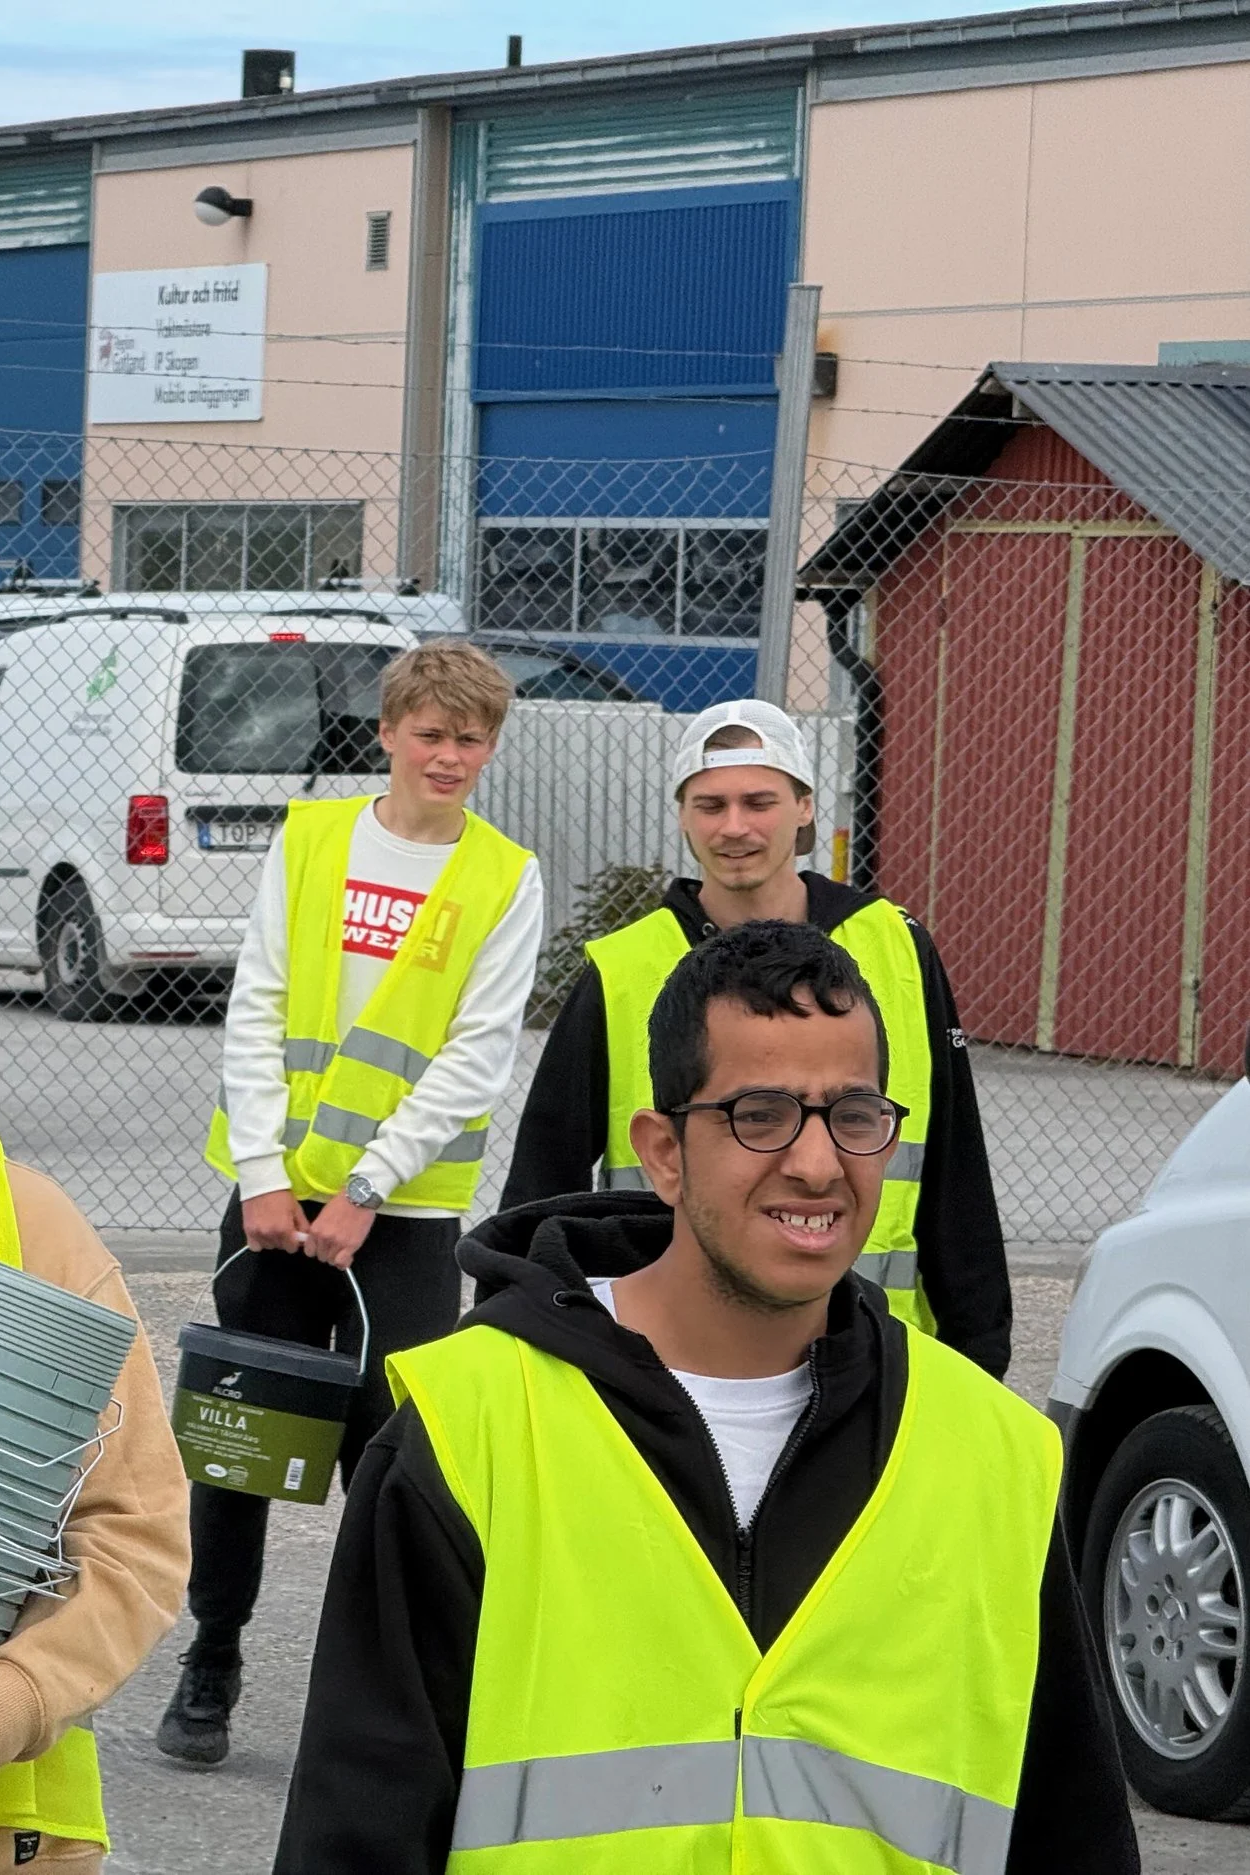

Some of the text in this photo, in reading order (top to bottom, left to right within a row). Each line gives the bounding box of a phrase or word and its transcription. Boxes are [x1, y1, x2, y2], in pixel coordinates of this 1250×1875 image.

[157, 280, 240, 305] Kultur och fritid
[212, 1386, 243, 1399] ALCRO
[199, 1406, 247, 1431] VILLA
